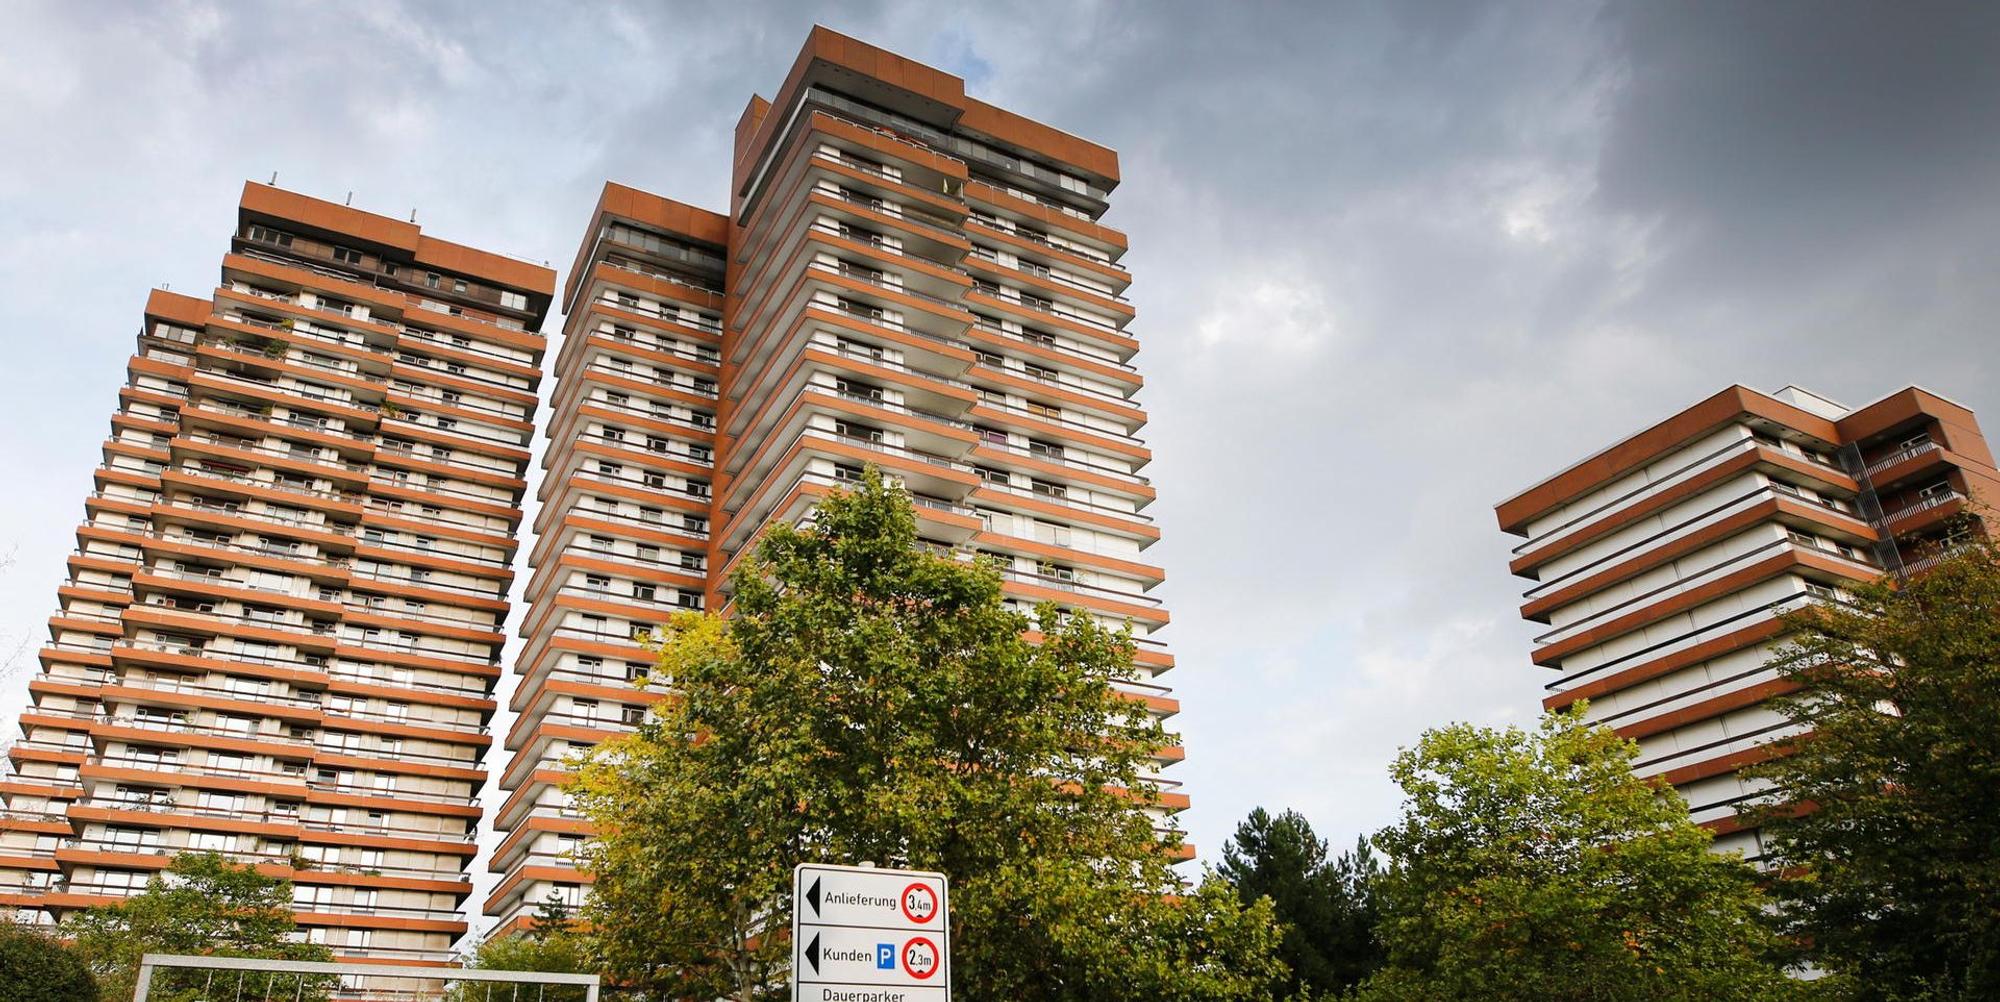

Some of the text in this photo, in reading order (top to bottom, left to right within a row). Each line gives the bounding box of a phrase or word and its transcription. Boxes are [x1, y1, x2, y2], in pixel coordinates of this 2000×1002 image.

[825, 892, 897, 911] Anlieferung
[823, 948, 891, 965] Kunden P
[823, 988, 905, 1002] Dauerparker
